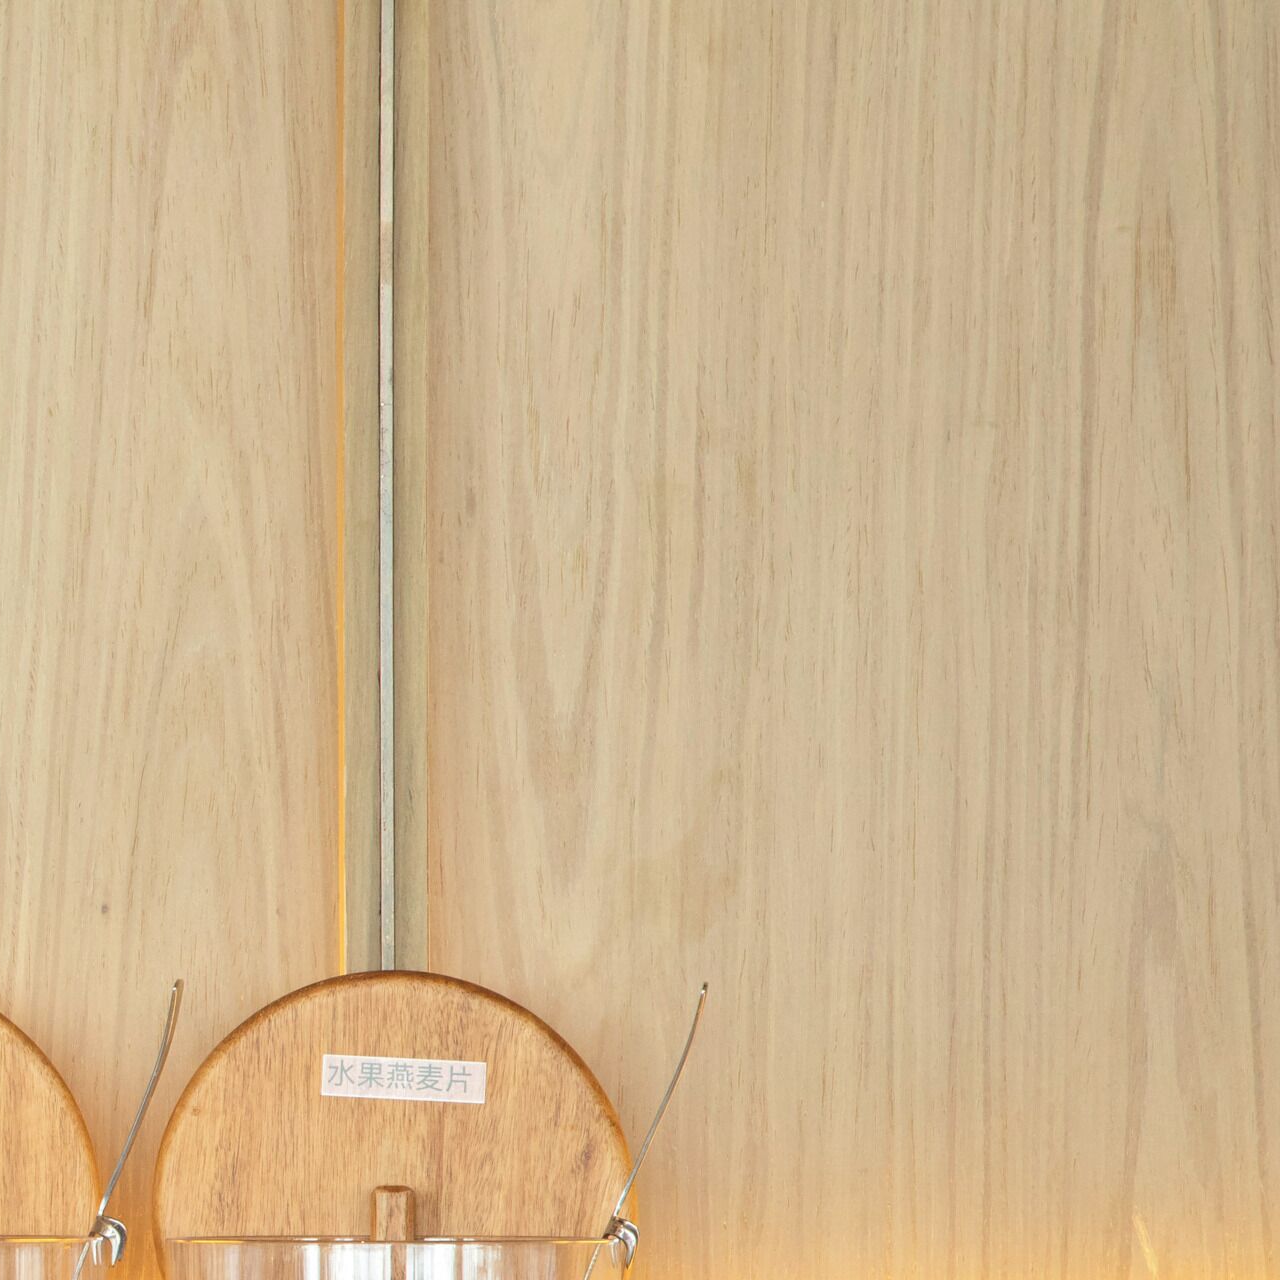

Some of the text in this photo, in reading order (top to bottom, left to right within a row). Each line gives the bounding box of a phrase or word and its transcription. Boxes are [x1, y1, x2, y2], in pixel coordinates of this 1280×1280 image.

[328, 1059, 473, 1094] 水果燕麦片
